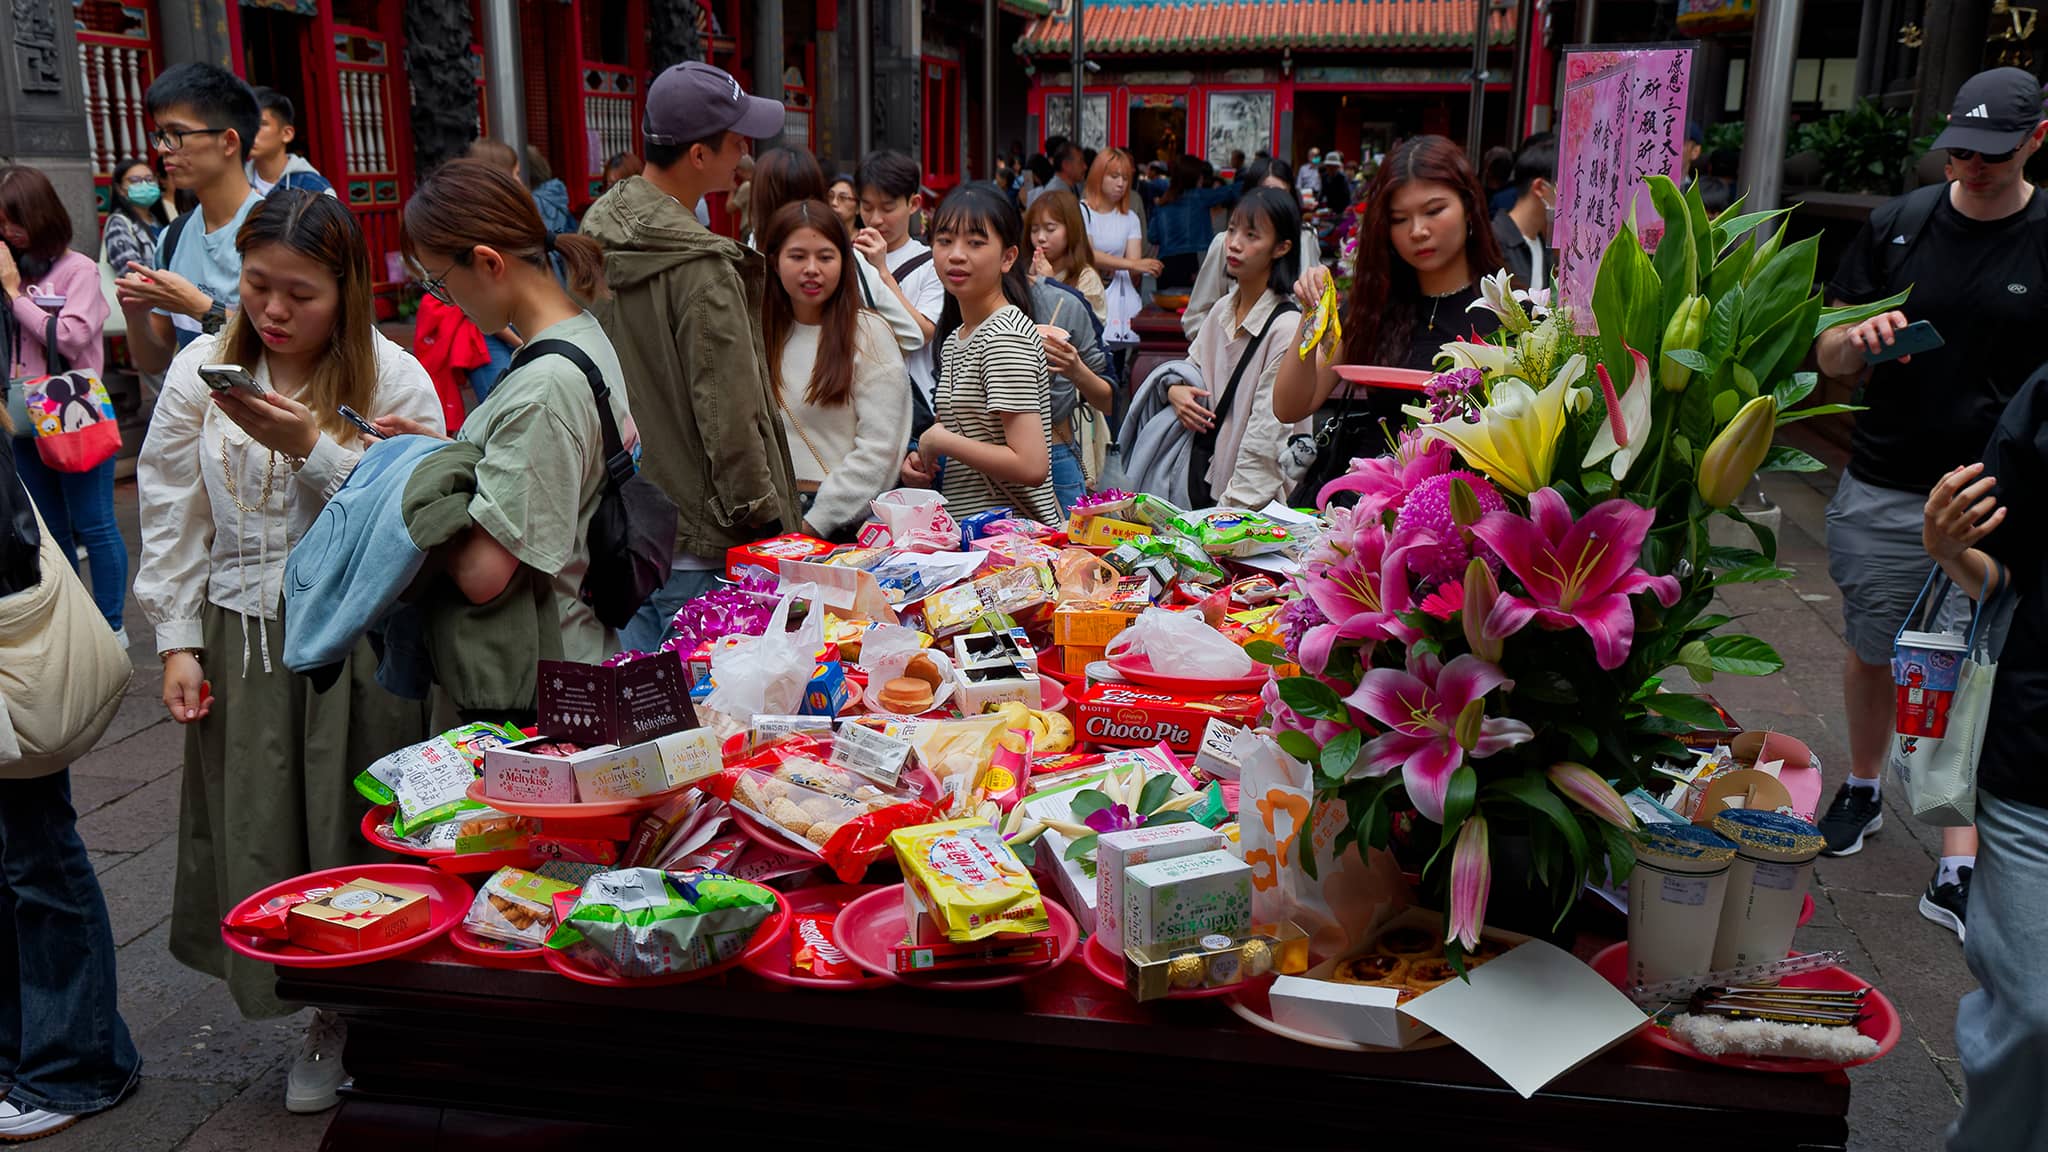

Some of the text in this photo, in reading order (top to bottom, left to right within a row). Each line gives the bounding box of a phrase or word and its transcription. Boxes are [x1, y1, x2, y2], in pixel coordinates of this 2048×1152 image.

[1087, 705, 1111, 713] LOTTE
[1085, 716, 1153, 742] Choco
[1152, 721, 1190, 744] Pie
[505, 772, 549, 787] Meltykiss
[1167, 911, 1239, 936] Meltykiss
